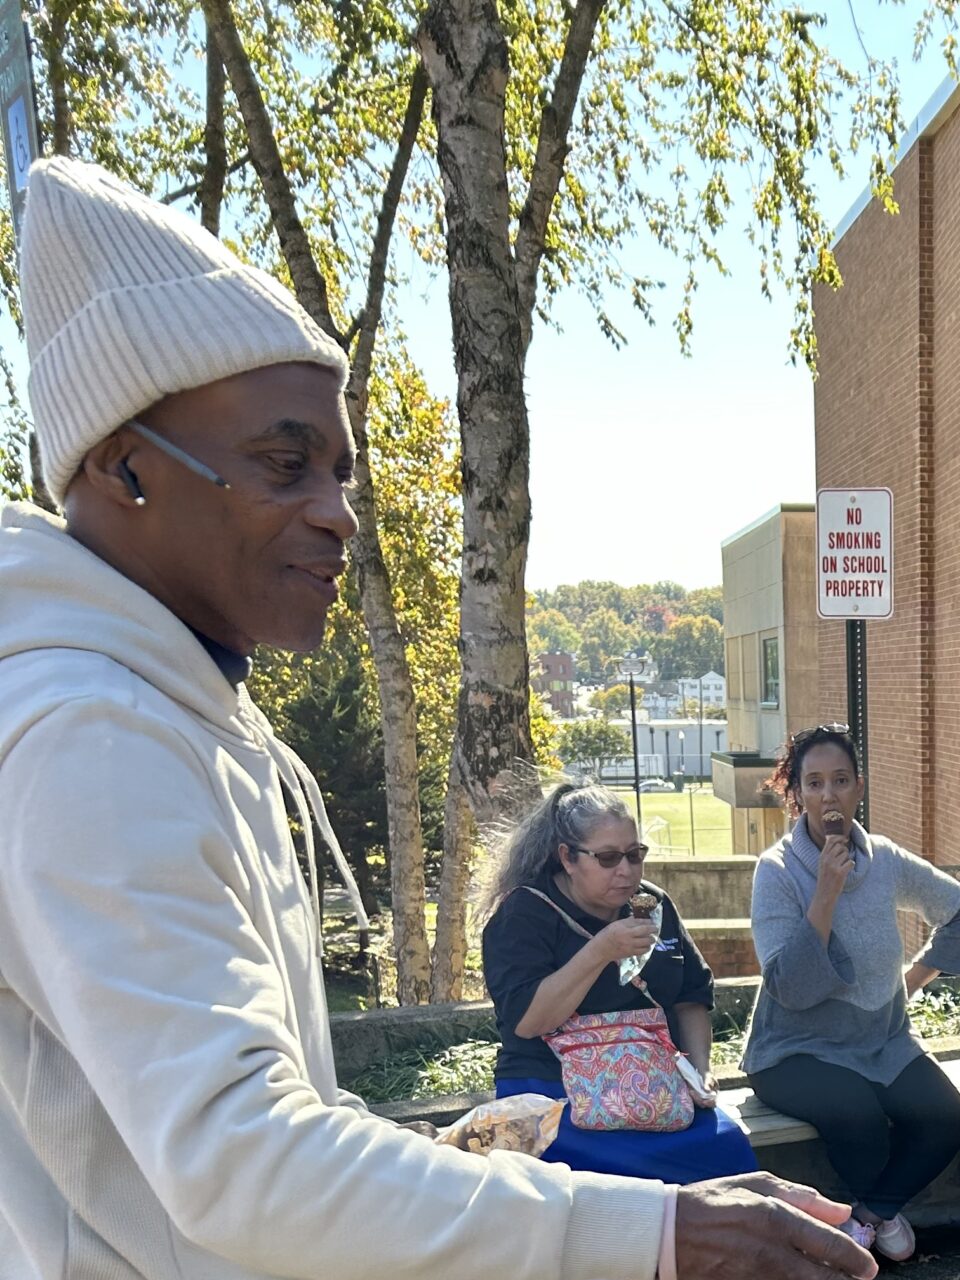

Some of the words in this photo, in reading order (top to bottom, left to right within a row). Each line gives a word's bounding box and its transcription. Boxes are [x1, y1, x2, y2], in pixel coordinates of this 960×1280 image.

[846, 507, 863, 525] NO
[827, 531, 882, 550] SMOKING
[822, 556, 838, 574] ON
[842, 555, 888, 574] SCHOOL
[825, 579, 884, 598] PROPERTY
